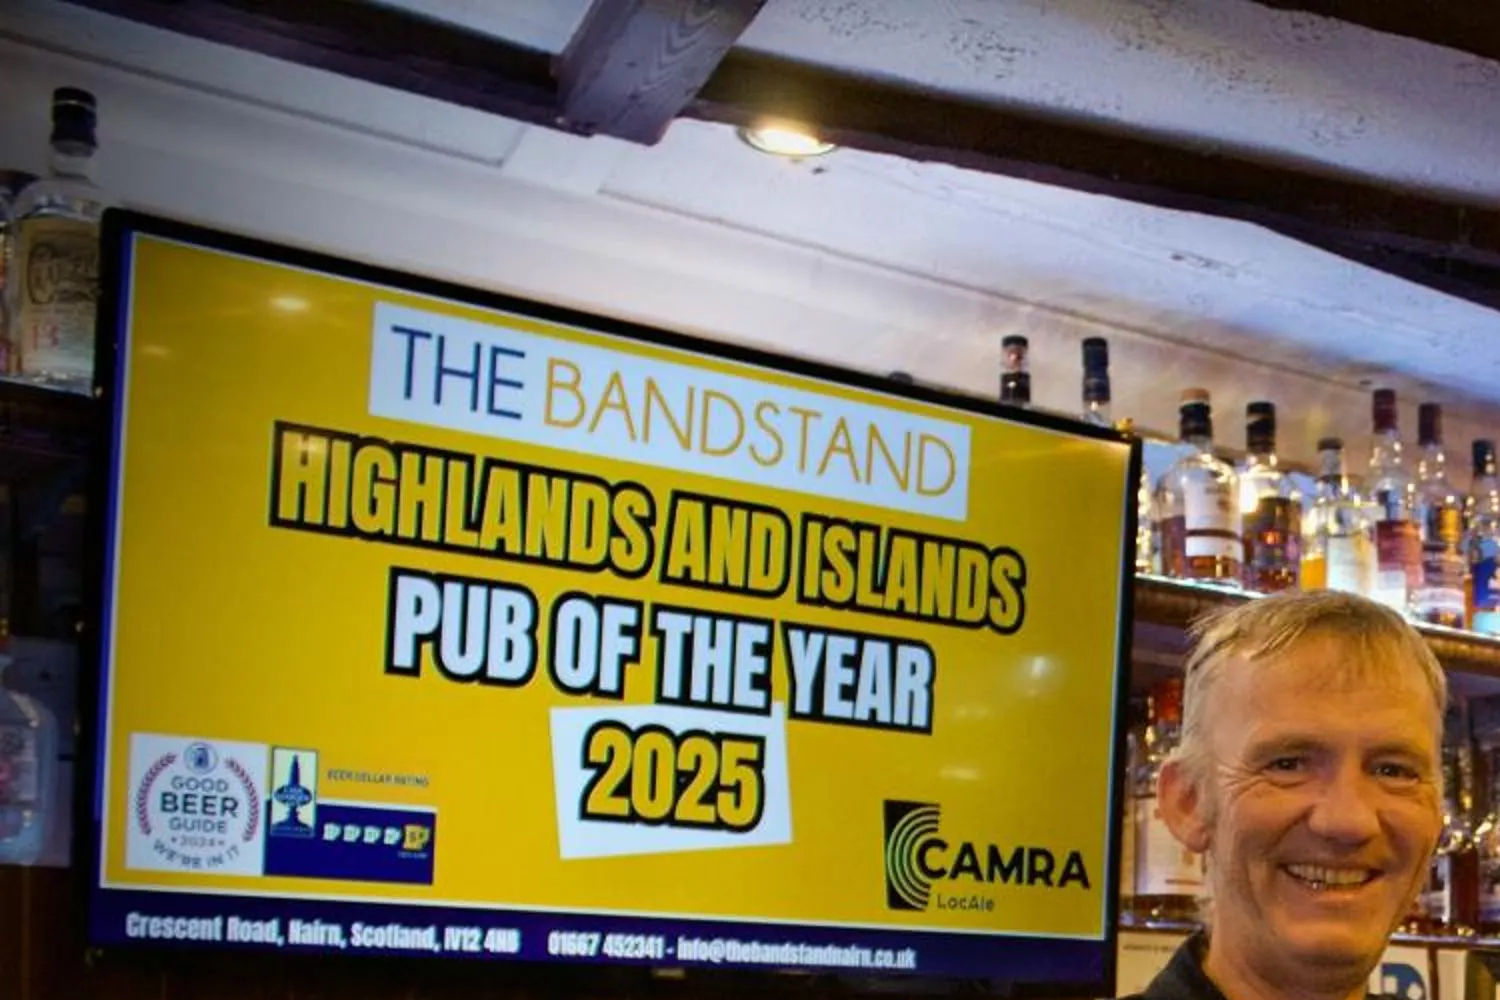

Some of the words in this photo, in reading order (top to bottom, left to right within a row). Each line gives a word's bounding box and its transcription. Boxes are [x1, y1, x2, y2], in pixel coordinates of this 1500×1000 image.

[391, 323, 526, 421] THE
[544, 356, 957, 498] BANDSTAND
[270, 422, 655, 575] HIGHLANDS
[662, 492, 791, 596] AND
[799, 515, 1026, 632] ISLANDS
[386, 569, 537, 686] PUB
[550, 590, 640, 697] OF
[656, 605, 772, 716] THE
[781, 623, 935, 733] YEAR
[170, 775, 229, 792] GOOD
[579, 720, 768, 831] 2025
[160, 791, 239, 818] BEER
[168, 816, 228, 834] GUIDE
[918, 837, 1091, 890] CAMRA
[936, 892, 995, 912] LocAle
[126, 912, 222, 940] Crescent
[227, 916, 283, 946] Road,
[288, 919, 347, 949] Nairn,
[351, 923, 440, 953] Scotland,
[444, 927, 481, 952] IV12
[548, 930, 600, 956] 01667
[603, 933, 664, 960] 452341
